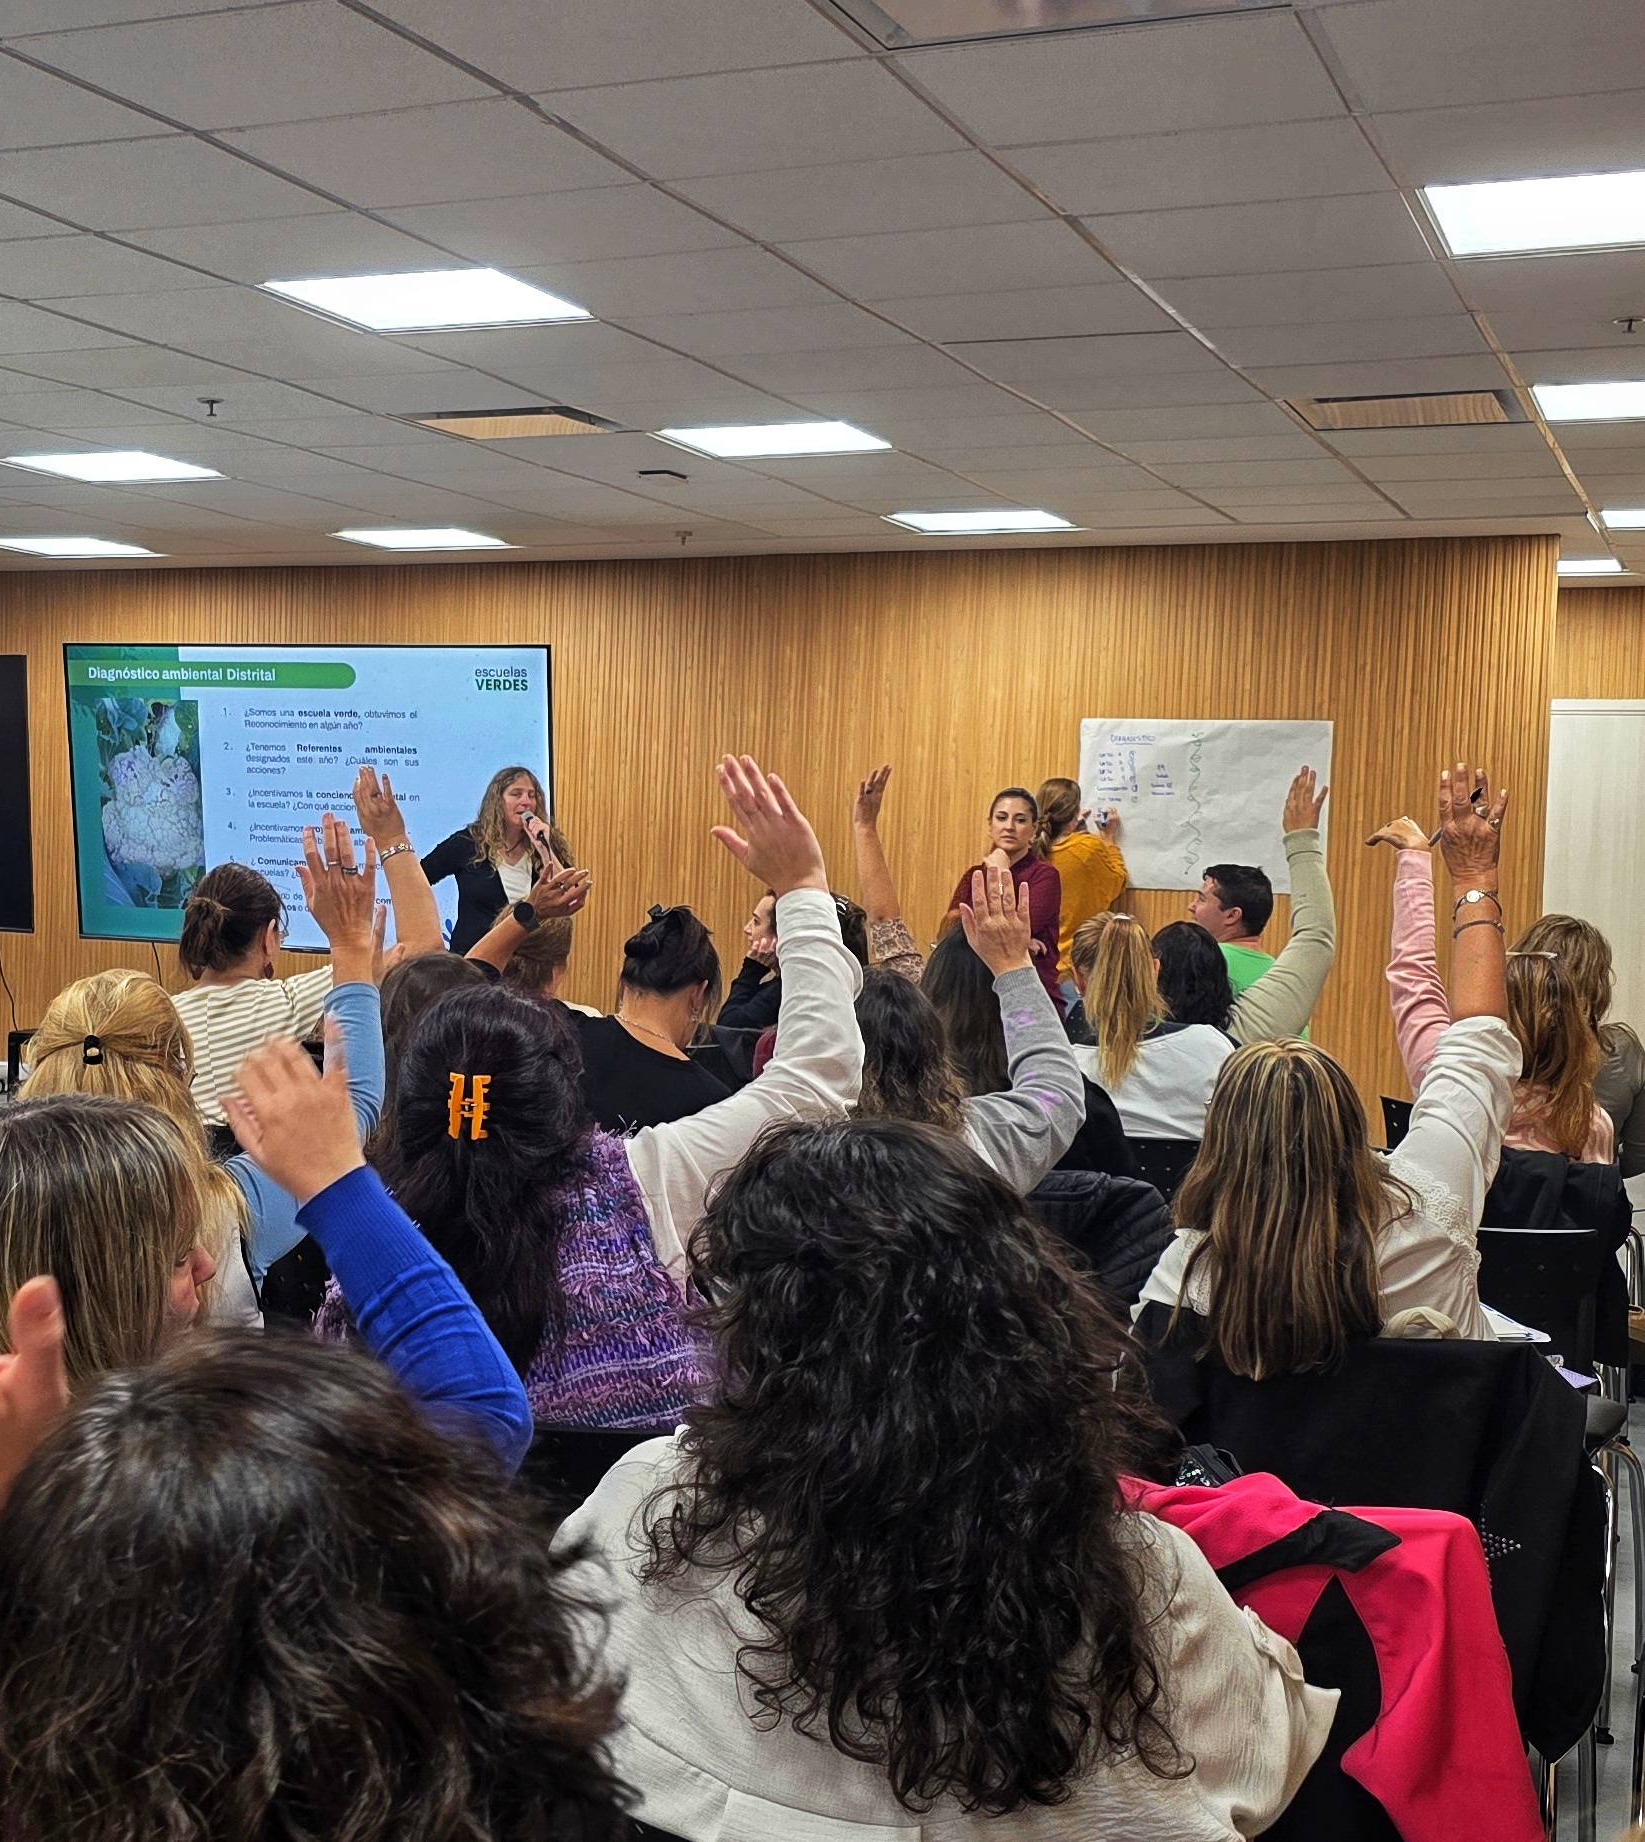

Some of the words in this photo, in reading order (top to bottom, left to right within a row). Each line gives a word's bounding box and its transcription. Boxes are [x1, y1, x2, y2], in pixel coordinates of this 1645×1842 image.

[88, 666, 160, 682] Diagnóstico
[162, 667, 223, 681] ambiental
[227, 668, 276, 682] Distrital
[475, 665, 528, 677] escuelas
[475, 679, 529, 691] VERDES
[244, 708, 277, 718] ¿Somos
[279, 709, 295, 718] una
[298, 709, 331, 718] escuela
[364, 709, 406, 719] obtuvimos
[409, 710, 418, 719] el
[244, 719, 307, 729] Reconocimiento
[309, 722, 319, 730] en
[343, 721, 363, 731] año?
[246, 743, 287, 752] ¿Tenemos
[296, 744, 343, 753] Referentes
[364, 746, 418, 755] ambientales
[245, 754, 291, 765] designados
[296, 756, 314, 765] este
[318, 755, 339, 765] año?
[383, 759, 399, 767] son
[404, 759, 420, 768] sus
[246, 766, 287, 775] acciones?
[305, 789, 313, 798] la
[315, 790, 355, 799] concienc
[409, 794, 421, 802] en
[248, 800, 256, 808] la
[256, 801, 291, 810] escuela?
[314, 802, 330, 811] qué
[330, 802, 357, 811] accion
[257, 856, 307, 866] Comunicam
